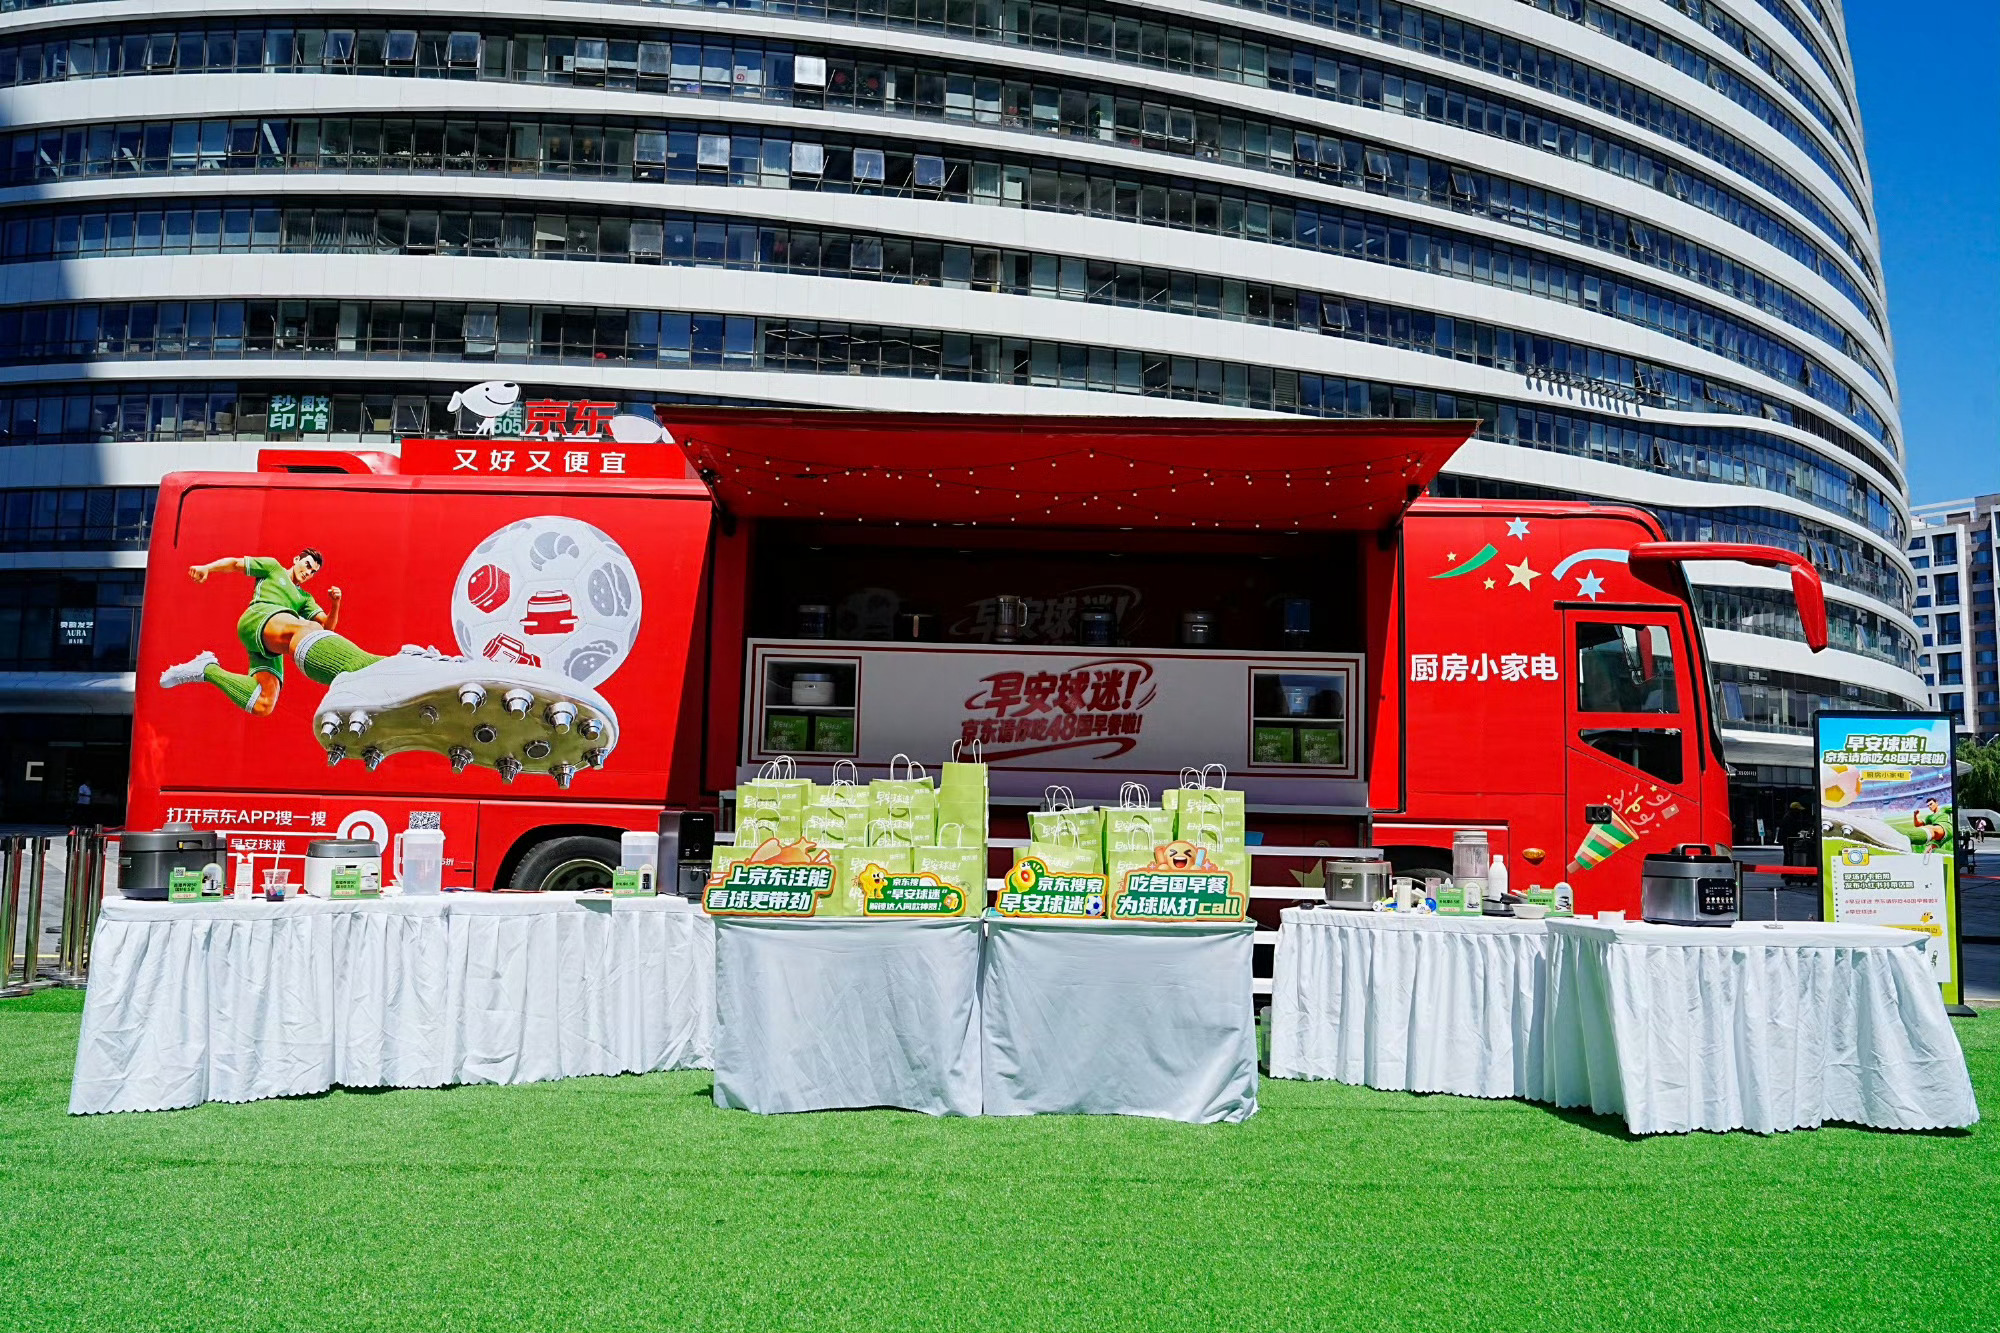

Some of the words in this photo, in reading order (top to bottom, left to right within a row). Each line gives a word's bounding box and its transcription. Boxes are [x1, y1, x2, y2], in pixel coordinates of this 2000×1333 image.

[494, 418, 522, 434] 505
[525, 399, 617, 436] 京东
[453, 449, 626, 474] 又好又便宜
[66, 629, 87, 637] AURA
[1410, 652, 1559, 682] 厨房小家电
[980, 667, 1142, 718] 早安球迷!
[1846, 736, 1926, 752] 早安球迷!
[1825, 752, 1945, 764] 京东请你吃48国早餐啦
[166, 807, 327, 826] 打开京东APP搜一搜
[230, 838, 286, 852] 早安球迷
[727, 867, 829, 888] 上京东注能
[892, 877, 918, 887] 京东搜
[1037, 876, 1104, 893] 京东搜索
[1129, 875, 1227, 894] 吃各国早餐
[708, 889, 812, 911] 看球更带劲
[1000, 893, 1085, 914] 早安球迷
[1117, 895, 1239, 916] 为球队打call
